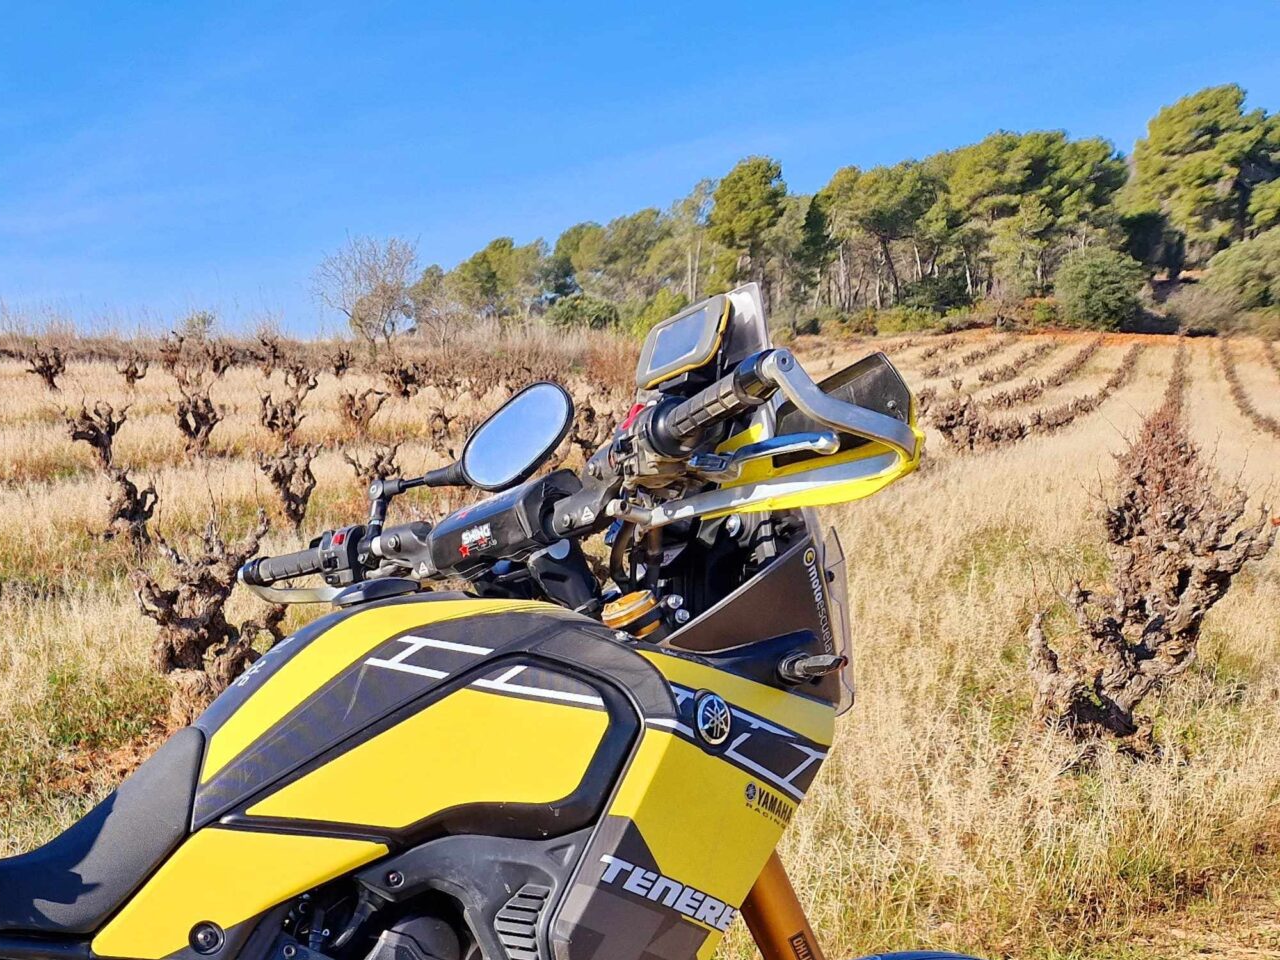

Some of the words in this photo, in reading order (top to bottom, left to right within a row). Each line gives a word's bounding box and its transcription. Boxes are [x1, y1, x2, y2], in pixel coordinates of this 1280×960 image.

[807, 565, 833, 654] motoescuela
[745, 802, 788, 830] RACING
[757, 786, 793, 824] YAMAHA
[599, 854, 740, 934] TENERE
